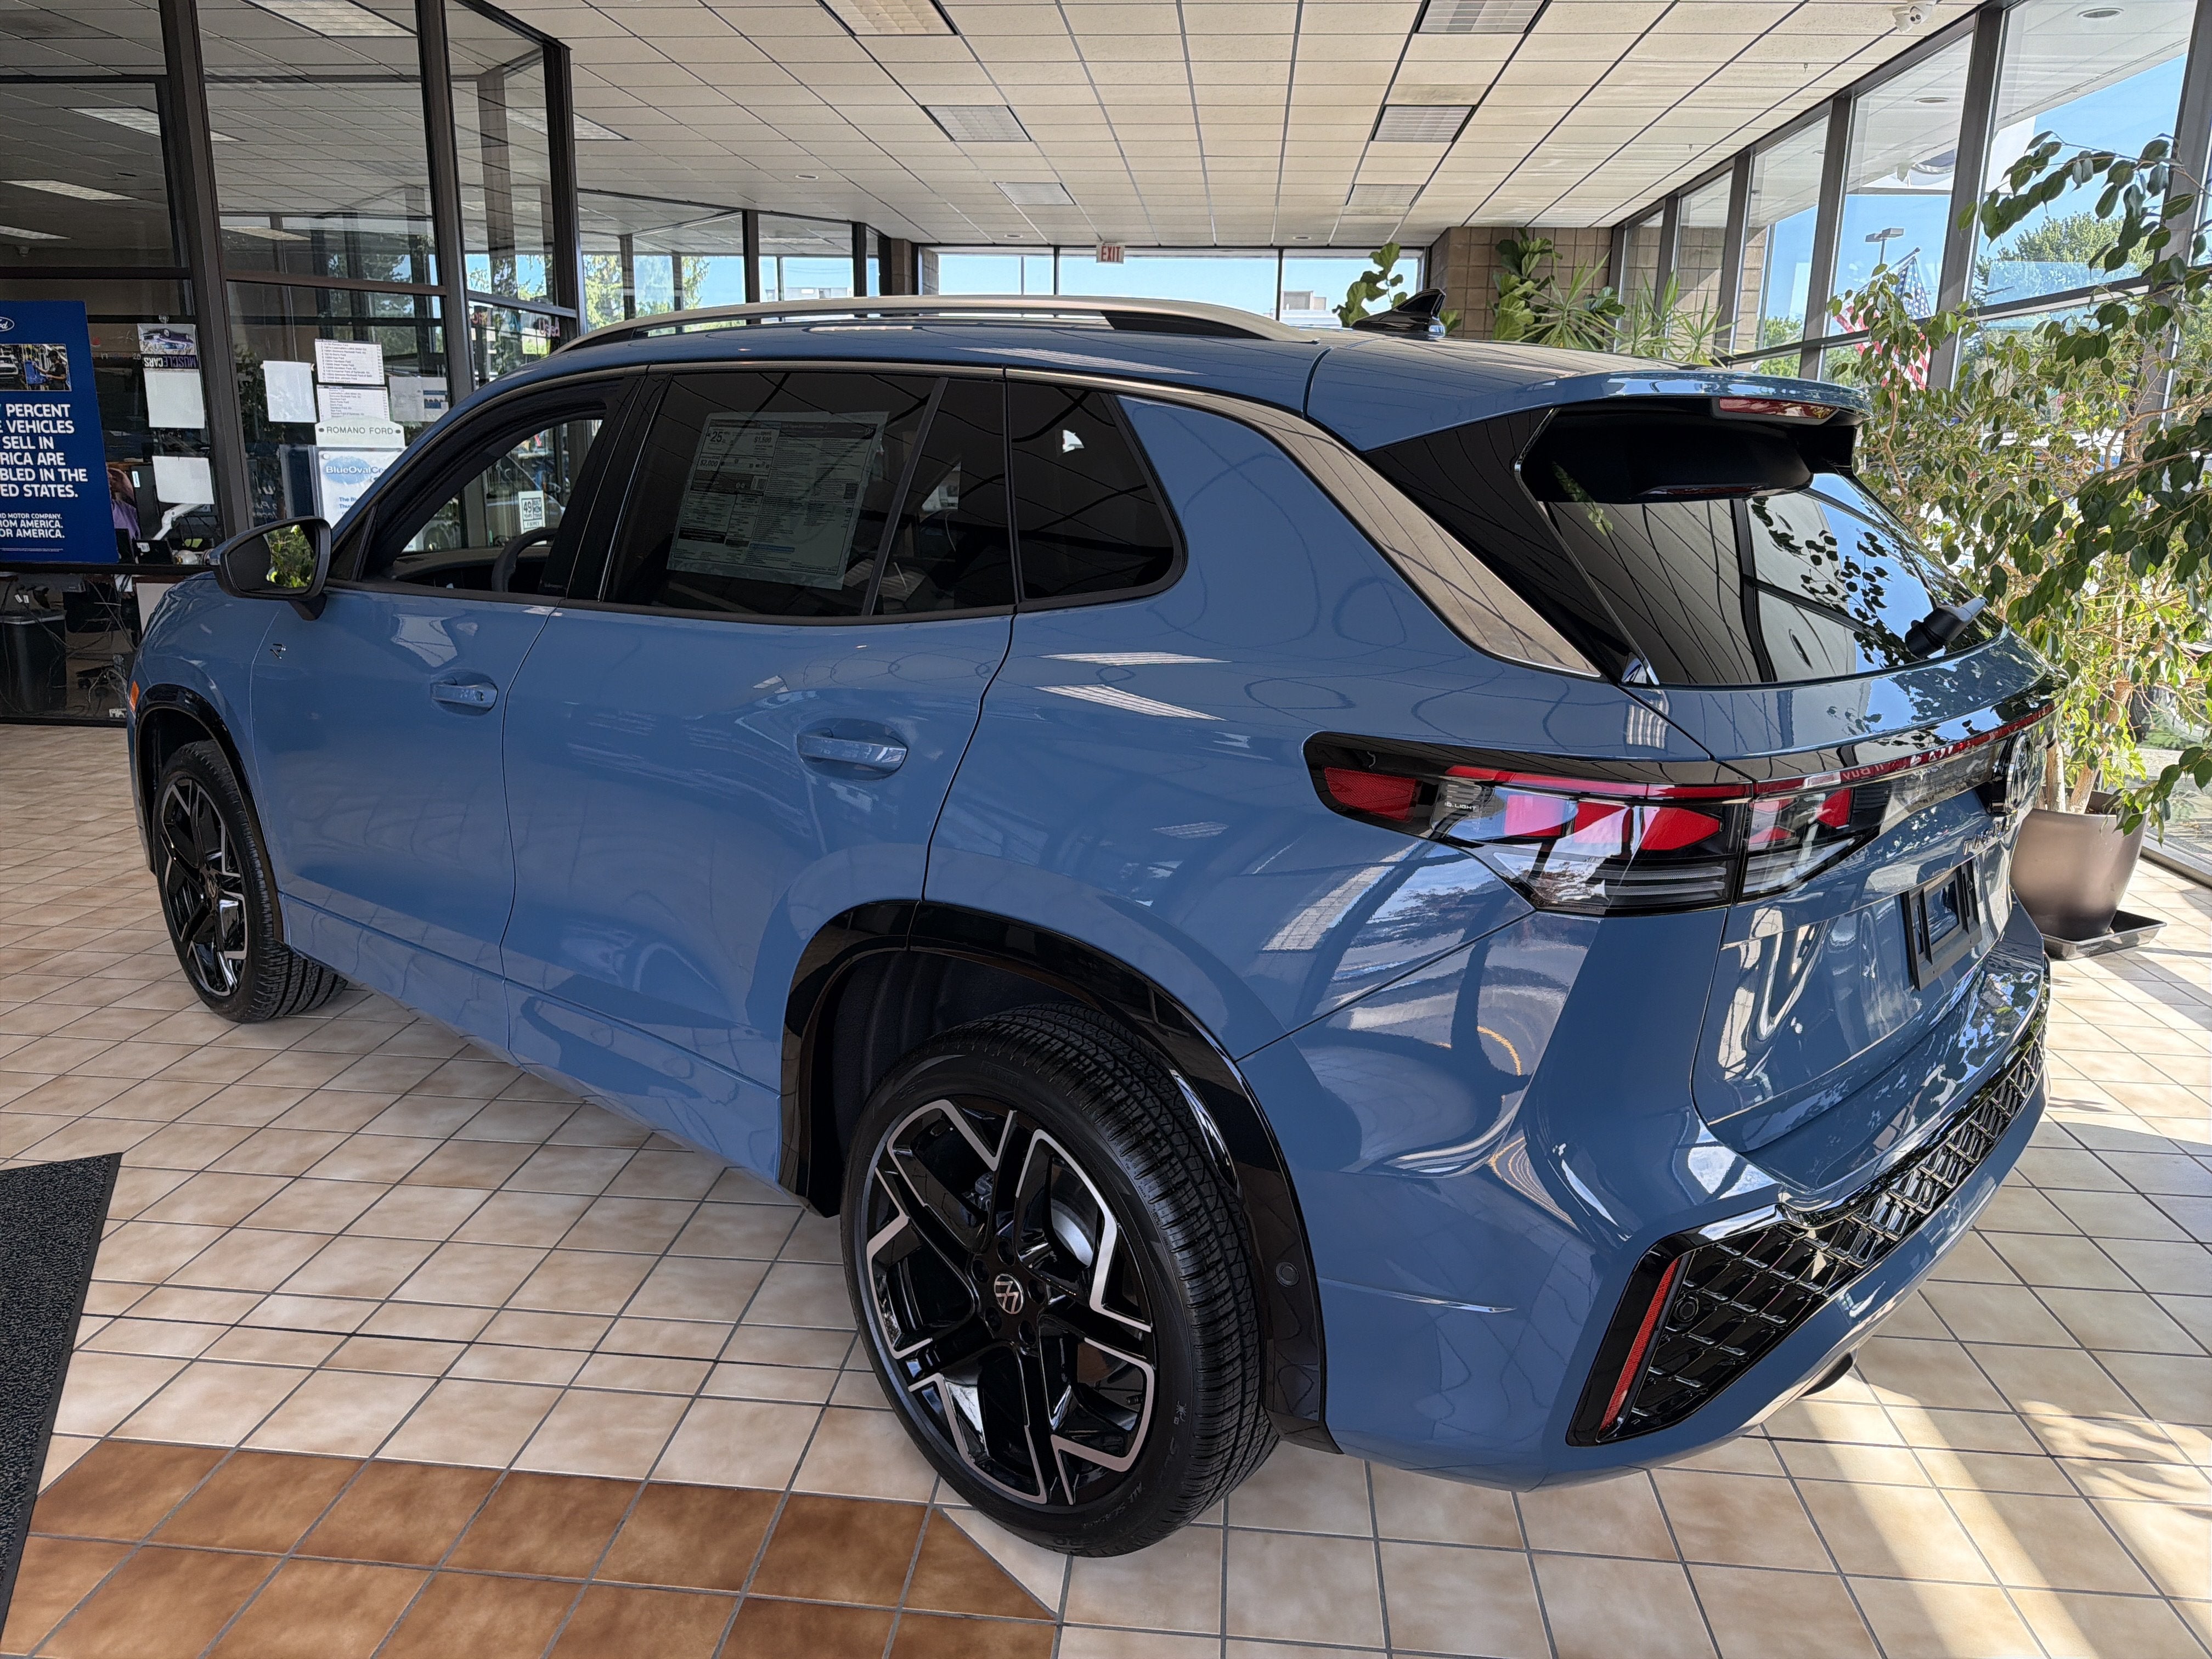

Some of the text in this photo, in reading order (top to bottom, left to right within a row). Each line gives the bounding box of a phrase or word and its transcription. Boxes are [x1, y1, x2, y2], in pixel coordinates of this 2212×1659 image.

[1101, 246, 1120, 262] EXIT
[5, 403, 71, 417] PERCENT
[5, 420, 75, 434] VEHICLES
[2, 436, 54, 449] SELL IN
[37, 452, 66, 465] ARE
[39, 468, 55, 482] IN
[58, 468, 88, 482] THE
[326, 466, 385, 474] BlueOvalCe
[23, 484, 78, 498] STATES.
[524, 501, 532, 513] 49
[20, 520, 64, 528] AMERICA.
[16, 528, 65, 538] AMERICA.
